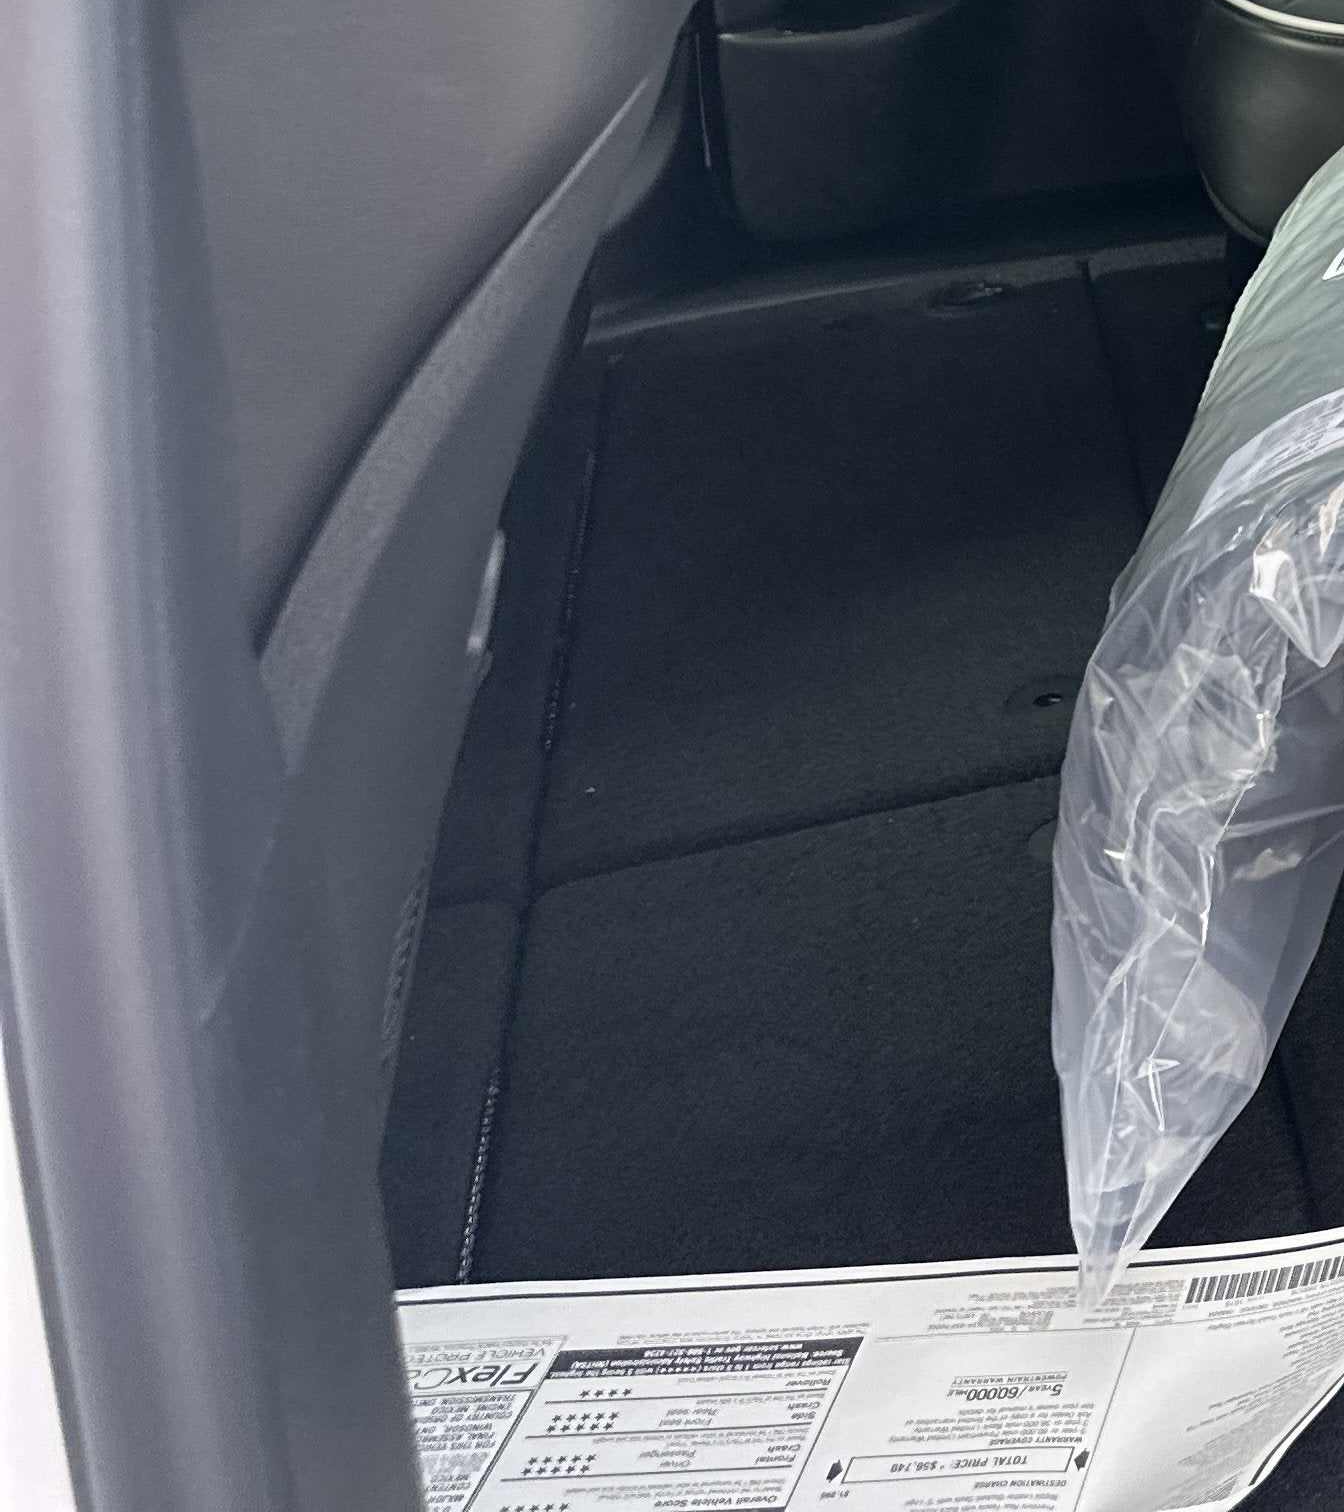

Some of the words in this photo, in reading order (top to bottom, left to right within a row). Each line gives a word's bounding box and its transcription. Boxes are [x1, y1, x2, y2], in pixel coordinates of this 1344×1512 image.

[405, 1352, 472, 1364] PROTEC
[476, 1347, 545, 1360] VEHICLE
[784, 1377, 832, 1389] Rollover
[951, 1377, 1004, 1385] WARRANTY
[1006, 1373, 1068, 1383] POWERTRAIN
[787, 1400, 821, 1411] Crash
[790, 1411, 816, 1420] Side
[988, 1437, 1034, 1446] COVERAGE
[1035, 1436, 1083, 1444] WARRANTY
[766, 1443, 801, 1454] Crash
[754, 1454, 797, 1465] Frontal
[993, 1455, 1029, 1466] TOTAL
[973, 1479, 1009, 1489] CHARGE
[1010, 1479, 1067, 1488] DESTINATION
[654, 1498, 689, 1509] Score
[690, 1496, 733, 1506] Vehicle
[736, 1494, 778, 1505] Overall
